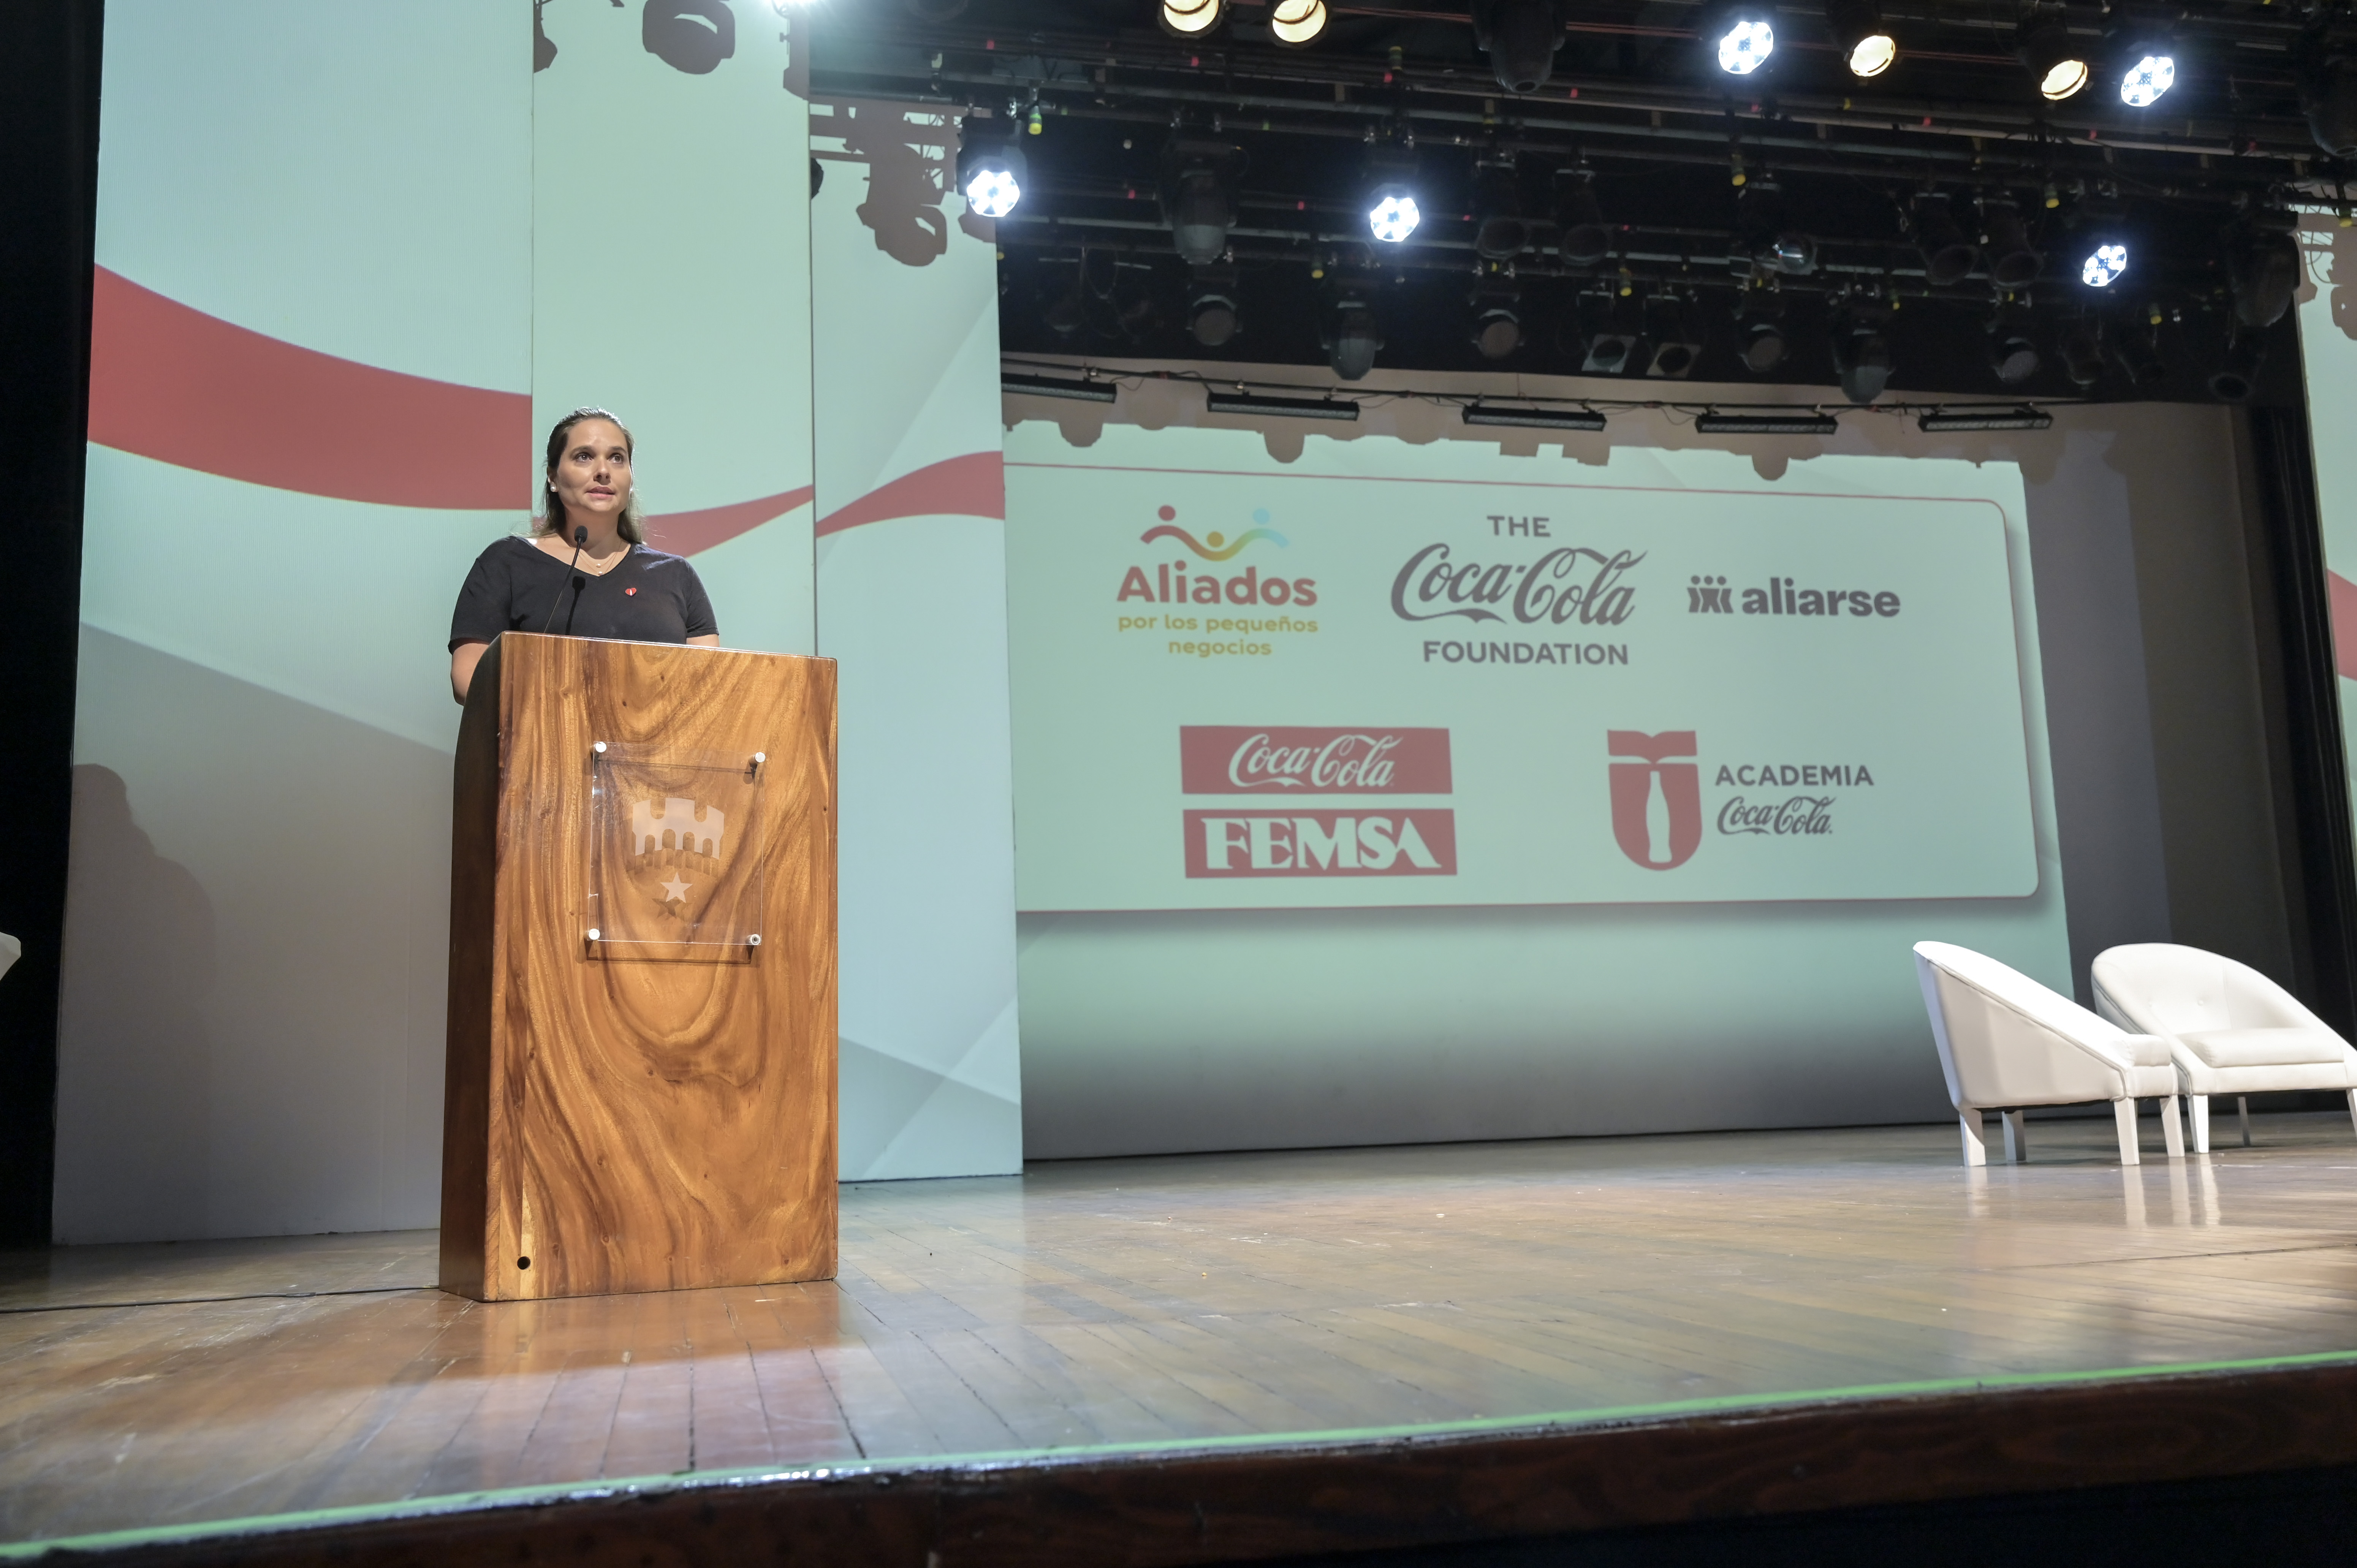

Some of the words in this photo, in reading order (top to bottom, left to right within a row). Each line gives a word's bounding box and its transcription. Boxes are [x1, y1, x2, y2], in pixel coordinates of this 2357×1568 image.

[1486, 515, 1551, 538] THE
[1116, 560, 1318, 607] Aliados
[1390, 543, 1648, 626] Coca-Cola
[1742, 577, 1901, 618] aliarse
[1118, 616, 1158, 632] por
[1164, 614, 1198, 631] los
[1205, 615, 1319, 635] pequeños
[1168, 638, 1273, 658] negocios
[1423, 640, 1629, 665] FOUNDATION
[1228, 733, 1403, 787] Coca-Cola
[1715, 765, 1874, 786] ACADEMIA
[1717, 796, 1836, 835] Coca-Cola
[1201, 816, 1441, 870] FEMSA
